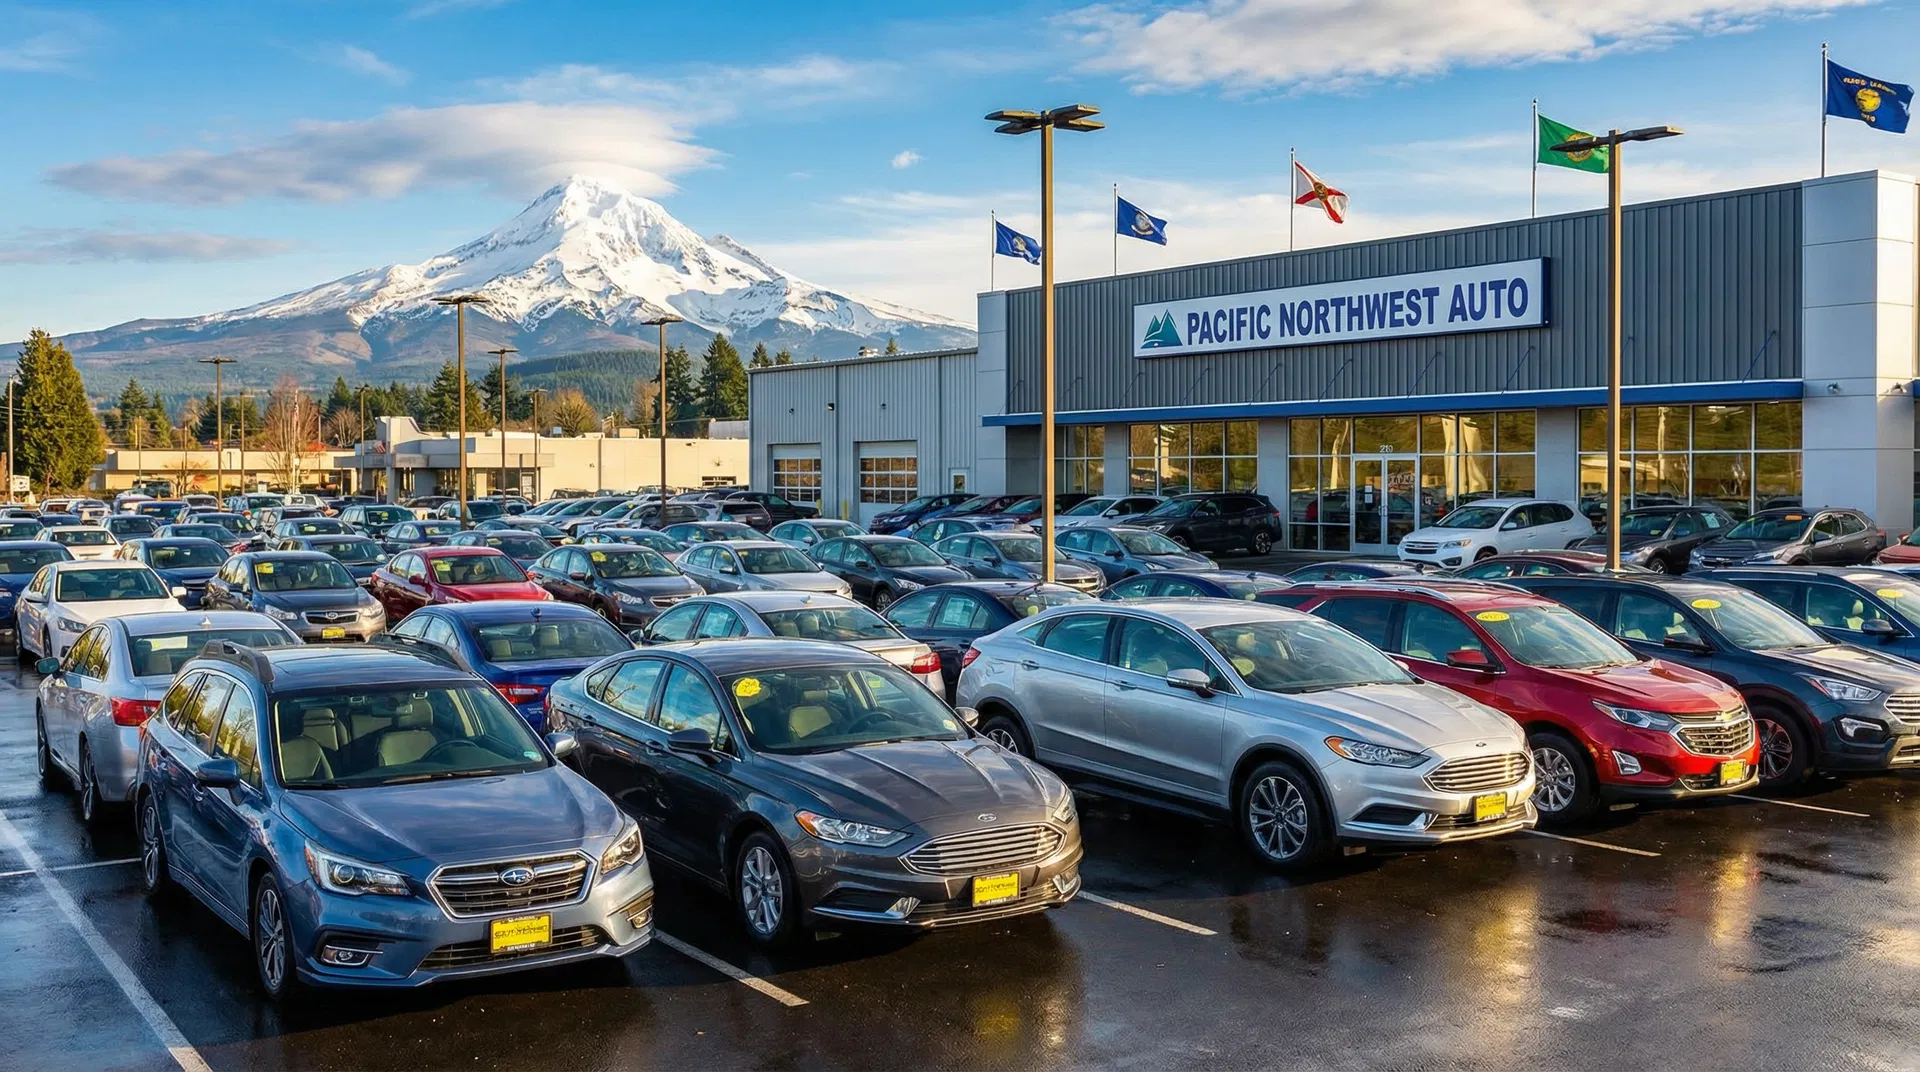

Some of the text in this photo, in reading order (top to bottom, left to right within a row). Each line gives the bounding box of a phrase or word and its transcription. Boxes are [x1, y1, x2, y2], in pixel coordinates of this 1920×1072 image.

[1187, 277, 1529, 346] PACIFIC NORTHWEST AUTO
